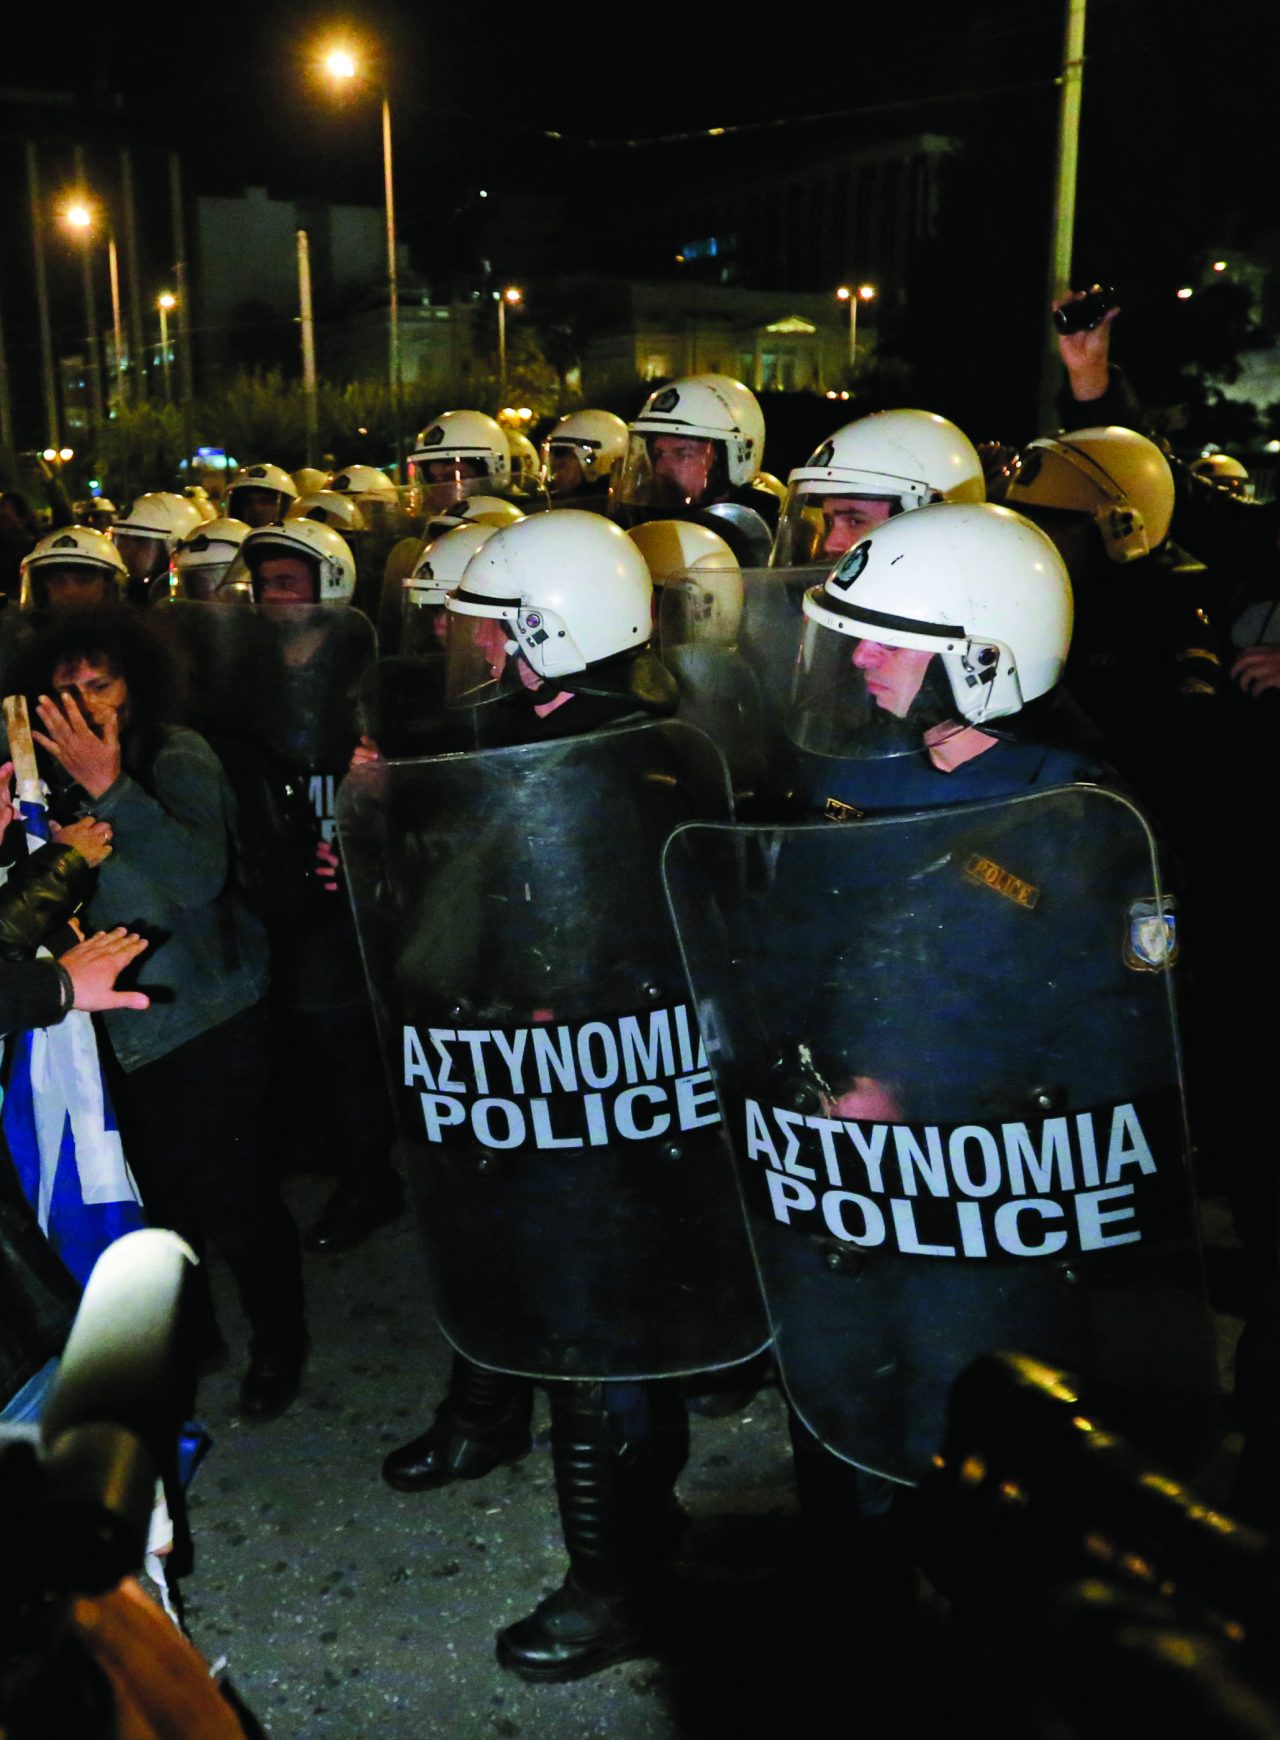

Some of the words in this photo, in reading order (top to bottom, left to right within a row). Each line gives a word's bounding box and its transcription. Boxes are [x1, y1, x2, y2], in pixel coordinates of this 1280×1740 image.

[971, 859, 1032, 902] POLICE
[420, 1071, 721, 1150] POLICE
[744, 1098, 1158, 1198] ΑΣΤΥΝΟΜΙΑ
[765, 1169, 1142, 1258] POLICE
